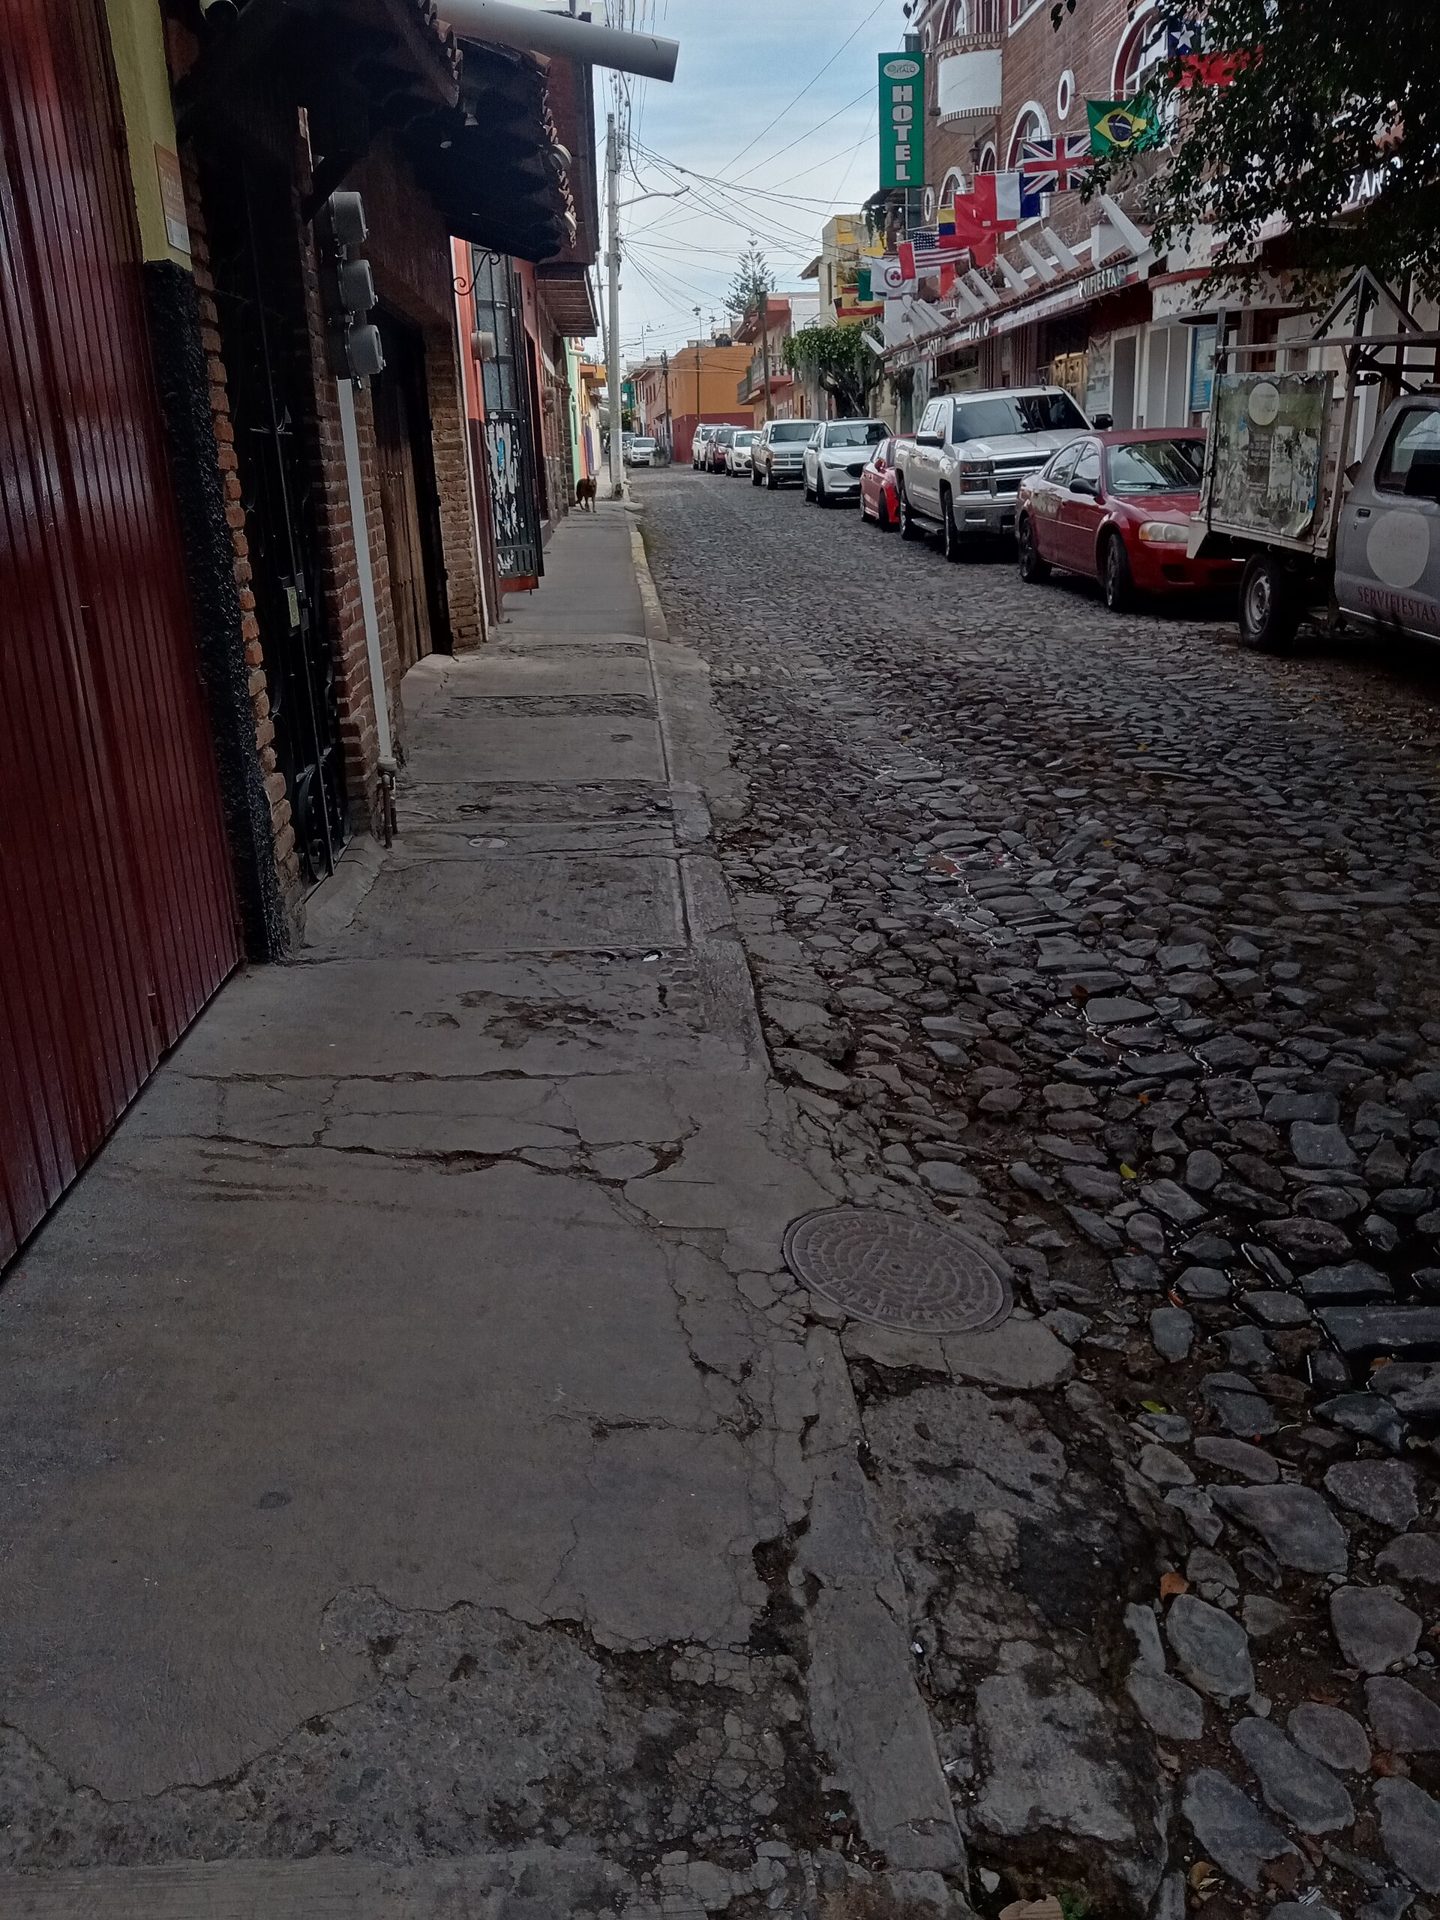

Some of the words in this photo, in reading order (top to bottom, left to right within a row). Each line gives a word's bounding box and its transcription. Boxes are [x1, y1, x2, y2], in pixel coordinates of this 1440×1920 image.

[891, 85, 913, 180] HOTEL
[969, 317, 990, 341] ITAO
[1358, 585, 1438, 622] SERVIFIESTAS
